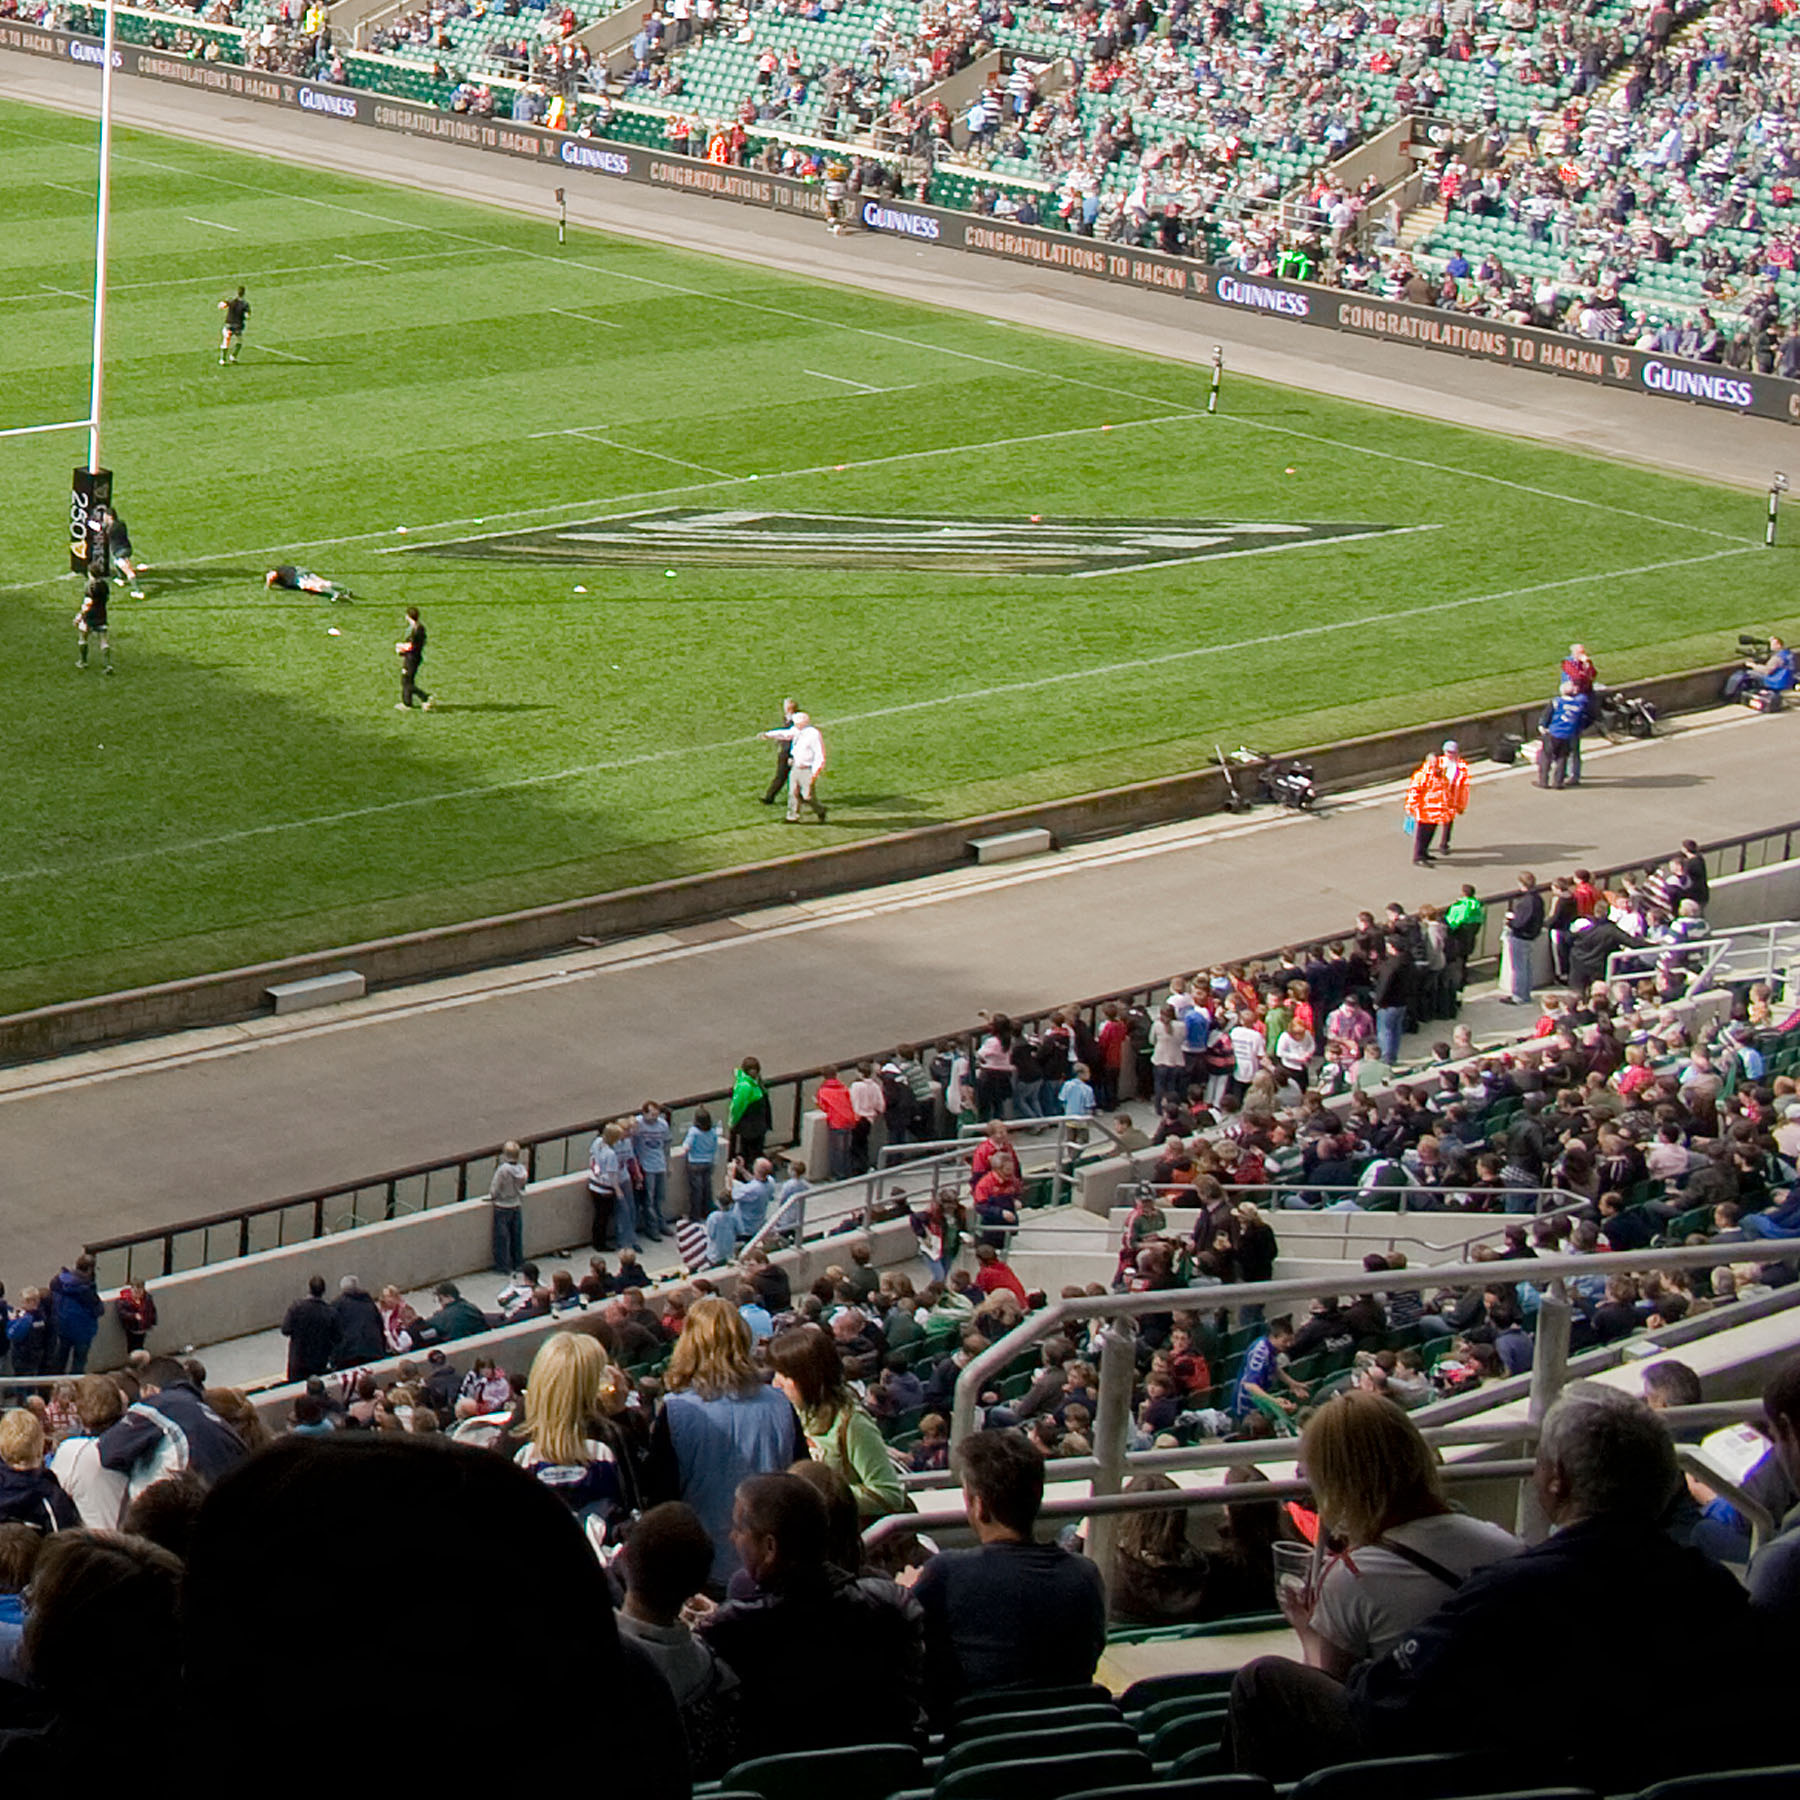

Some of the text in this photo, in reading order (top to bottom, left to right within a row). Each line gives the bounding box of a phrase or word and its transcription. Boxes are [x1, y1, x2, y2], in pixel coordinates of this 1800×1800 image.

[69, 40, 124, 68] GUINNSS
[138, 55, 281, 99] CONGRATULATIONS TO HACKN
[299, 87, 358, 118] GUINNESS
[374, 105, 540, 154] CONGRATULATIONS TO HACKN
[561, 141, 632, 174] GUINNESS
[650, 162, 770, 202] CONGRATULATIONS
[774, 185, 791, 204] TO
[863, 201, 941, 239] GUINNESS
[964, 225, 1187, 288] CONGRATULATIONS TO HACKN
[1217, 275, 1310, 317] GUINNESS
[1339, 304, 1604, 376] CONGRATULATIONS TO HACKN
[1642, 359, 1753, 407] GUINNESS
[69, 490, 89, 541] 250
